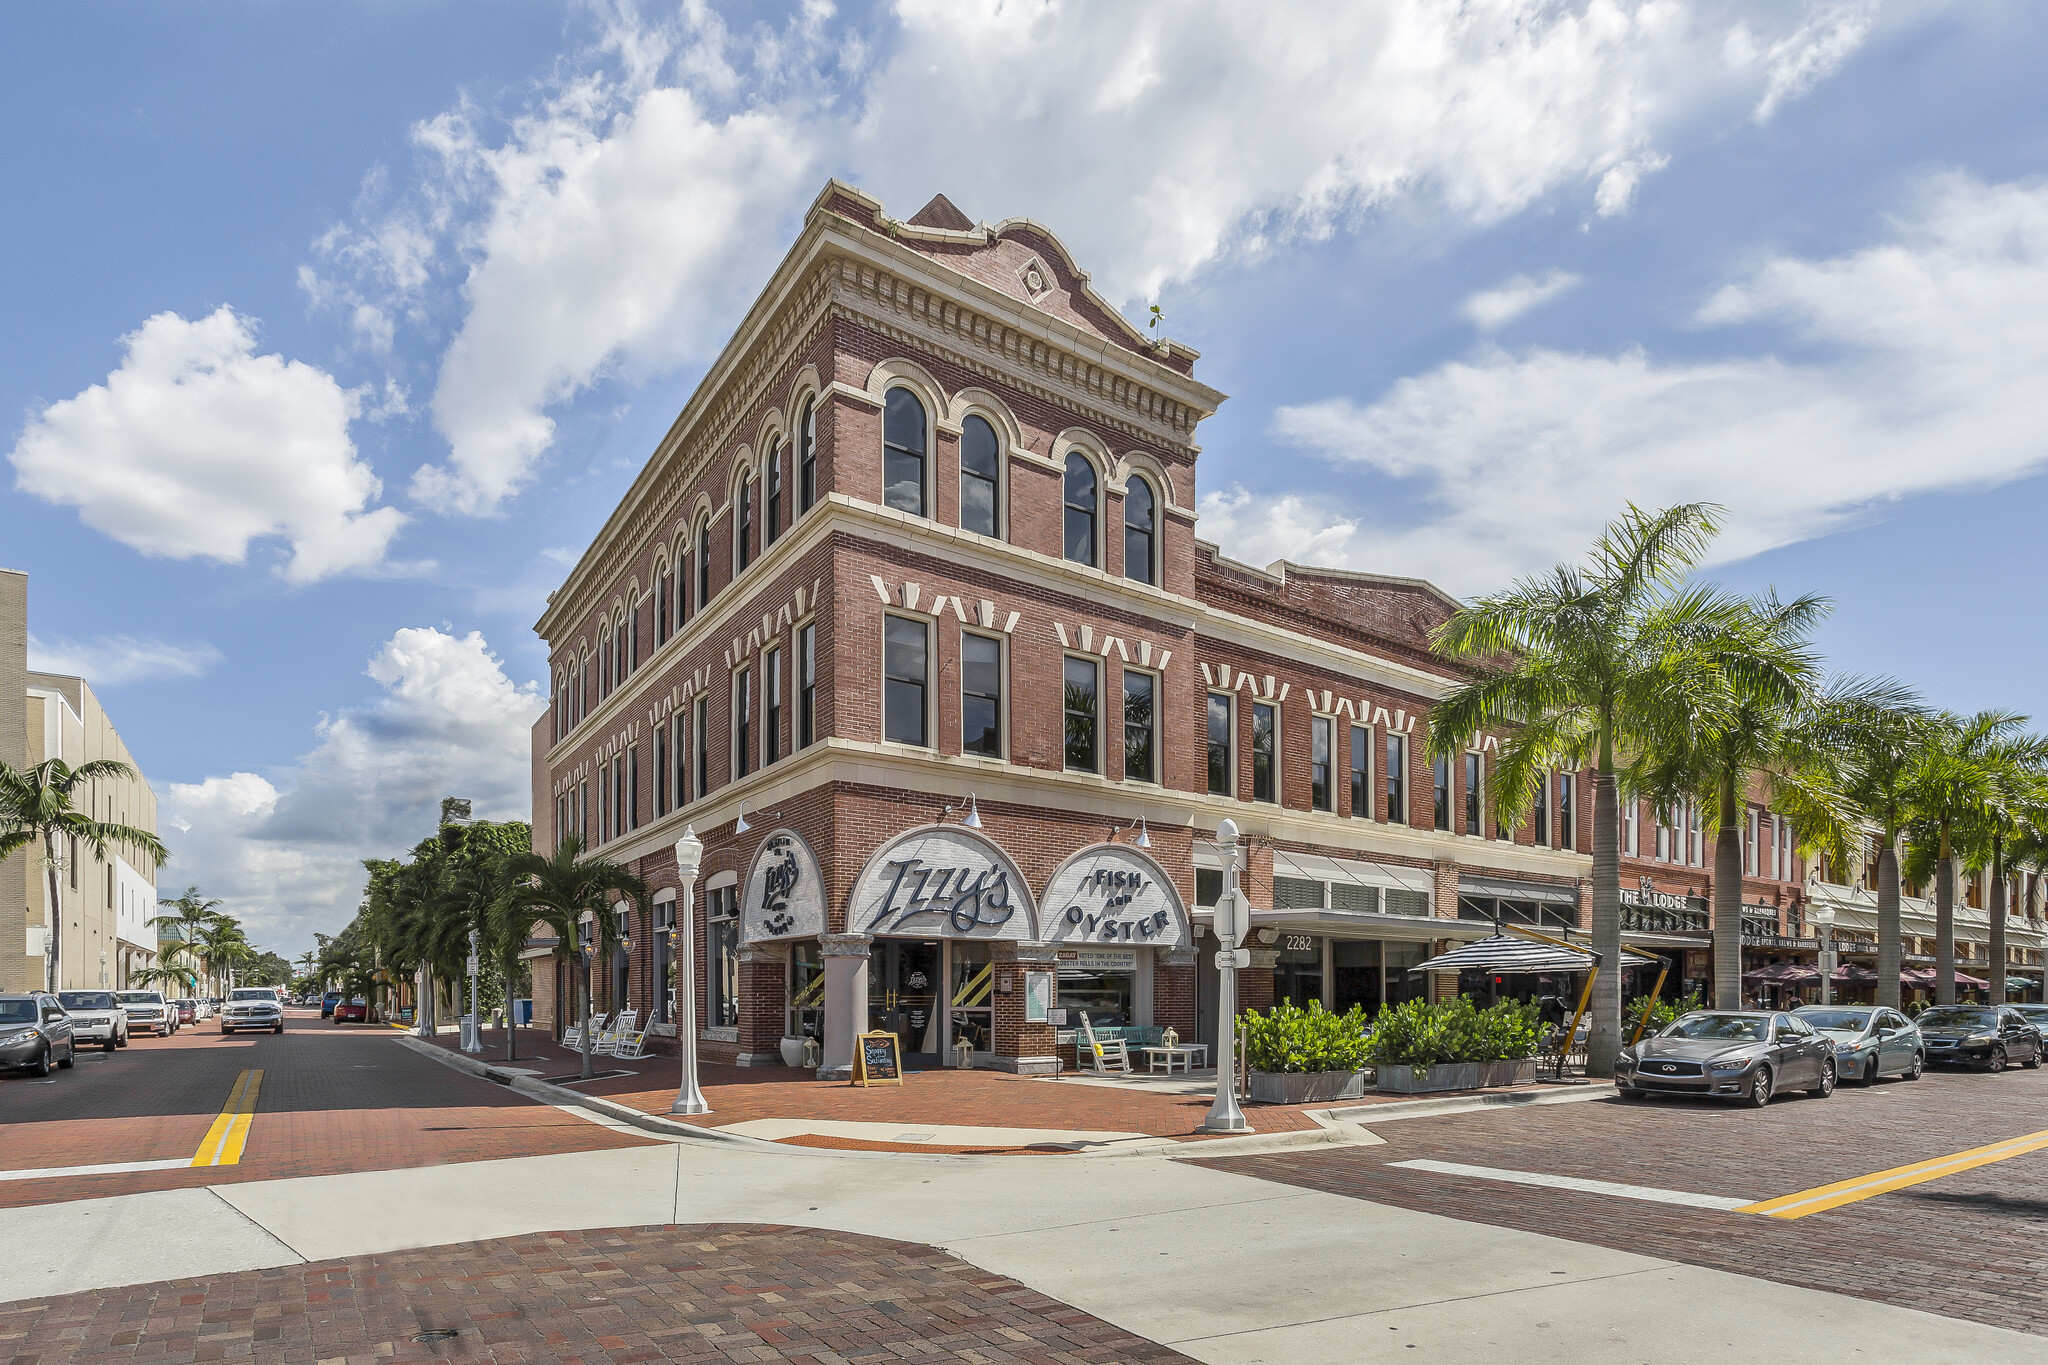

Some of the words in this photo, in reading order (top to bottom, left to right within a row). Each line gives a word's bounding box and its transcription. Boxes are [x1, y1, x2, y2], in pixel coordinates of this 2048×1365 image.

[1095, 869, 1141, 888] FISH
[866, 858, 1015, 933] Izzy's
[1106, 894, 1132, 908] AND
[1619, 889, 1640, 905] THE
[1652, 893, 1687, 909] LODGE
[1066, 905, 1170, 940] OYSTER
[1286, 935, 1312, 950] 2282
